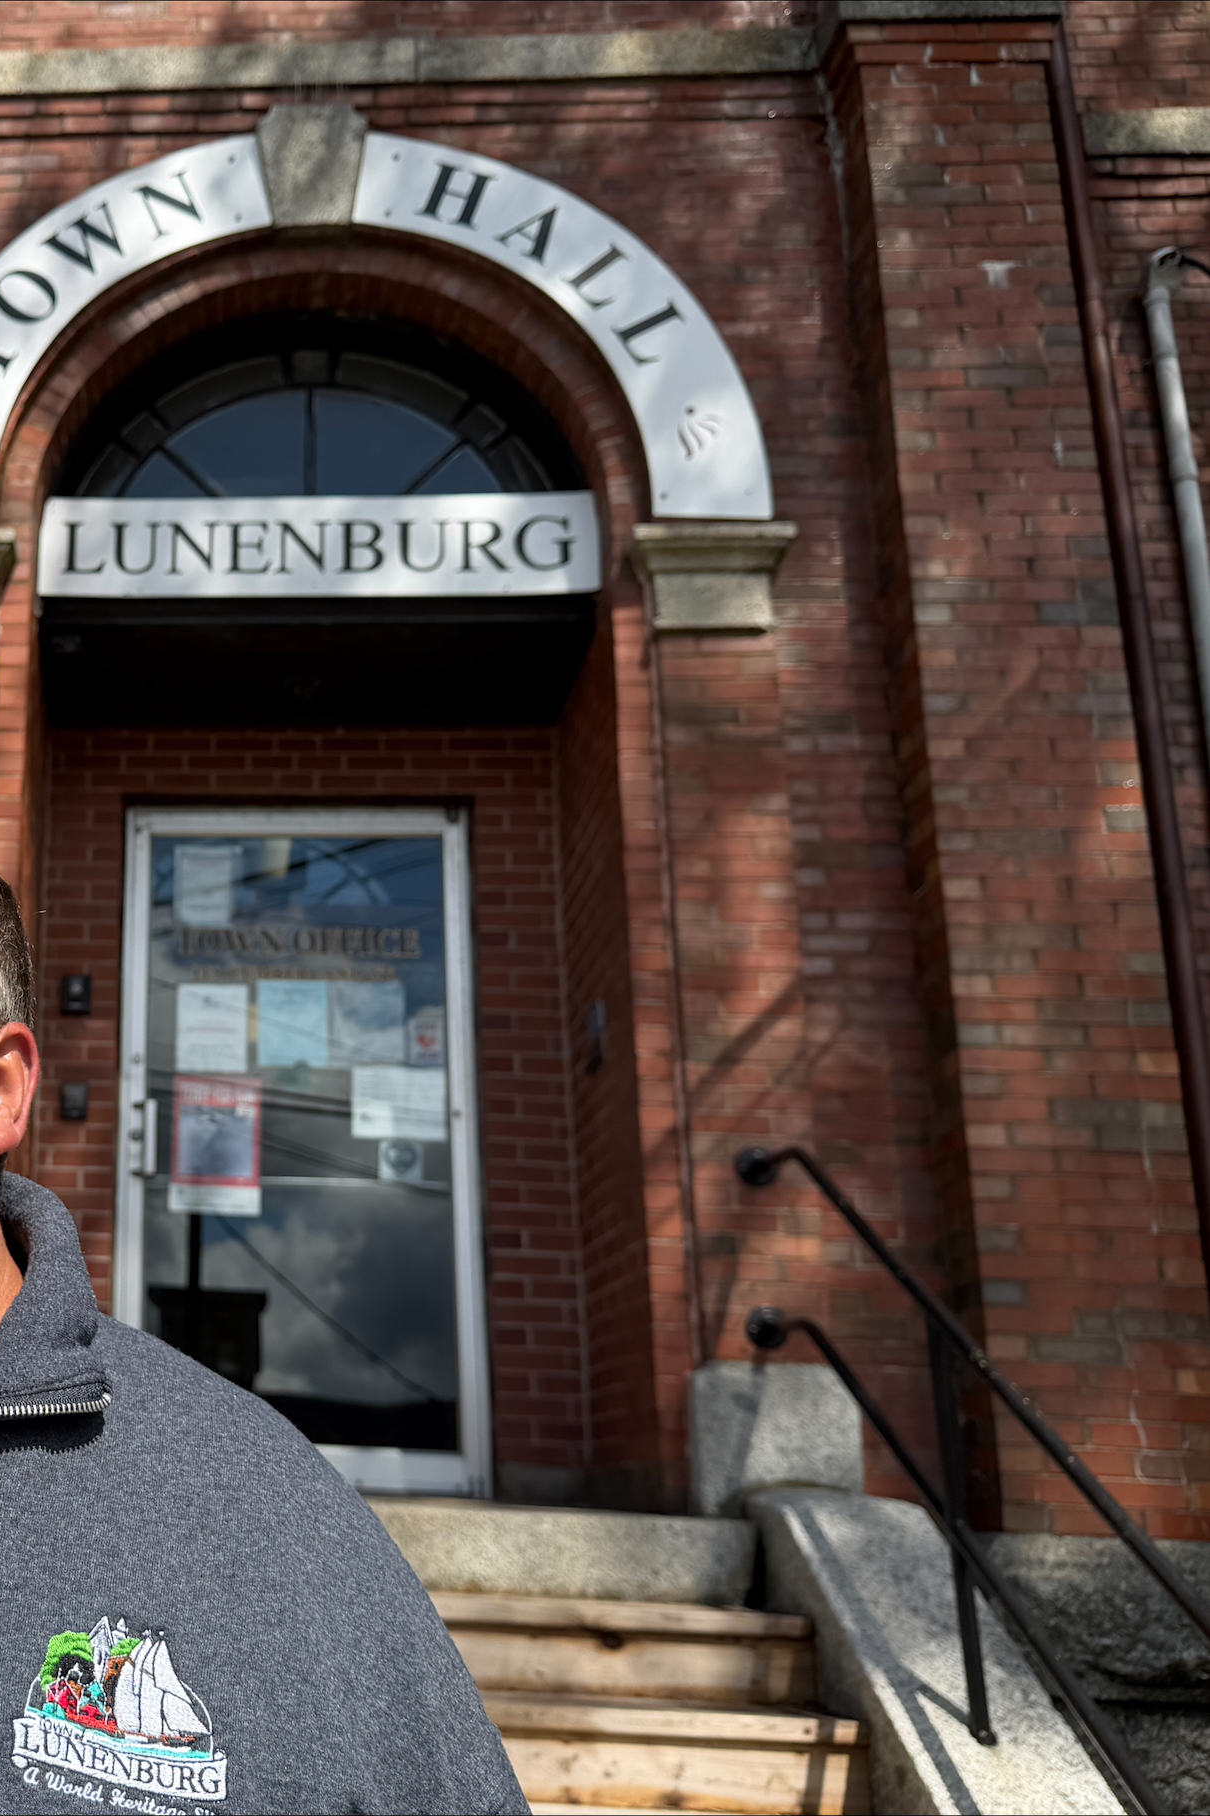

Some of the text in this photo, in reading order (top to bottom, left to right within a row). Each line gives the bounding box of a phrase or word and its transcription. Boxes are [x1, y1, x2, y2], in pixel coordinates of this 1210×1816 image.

[420, 162, 687, 368] HALL
[63, 514, 576, 576] LUNENBURG
[178, 926, 421, 959] TOWN OFFICE
[19, 1723, 222, 1794] LUNENBURG
[46, 1770, 104, 1802] World
